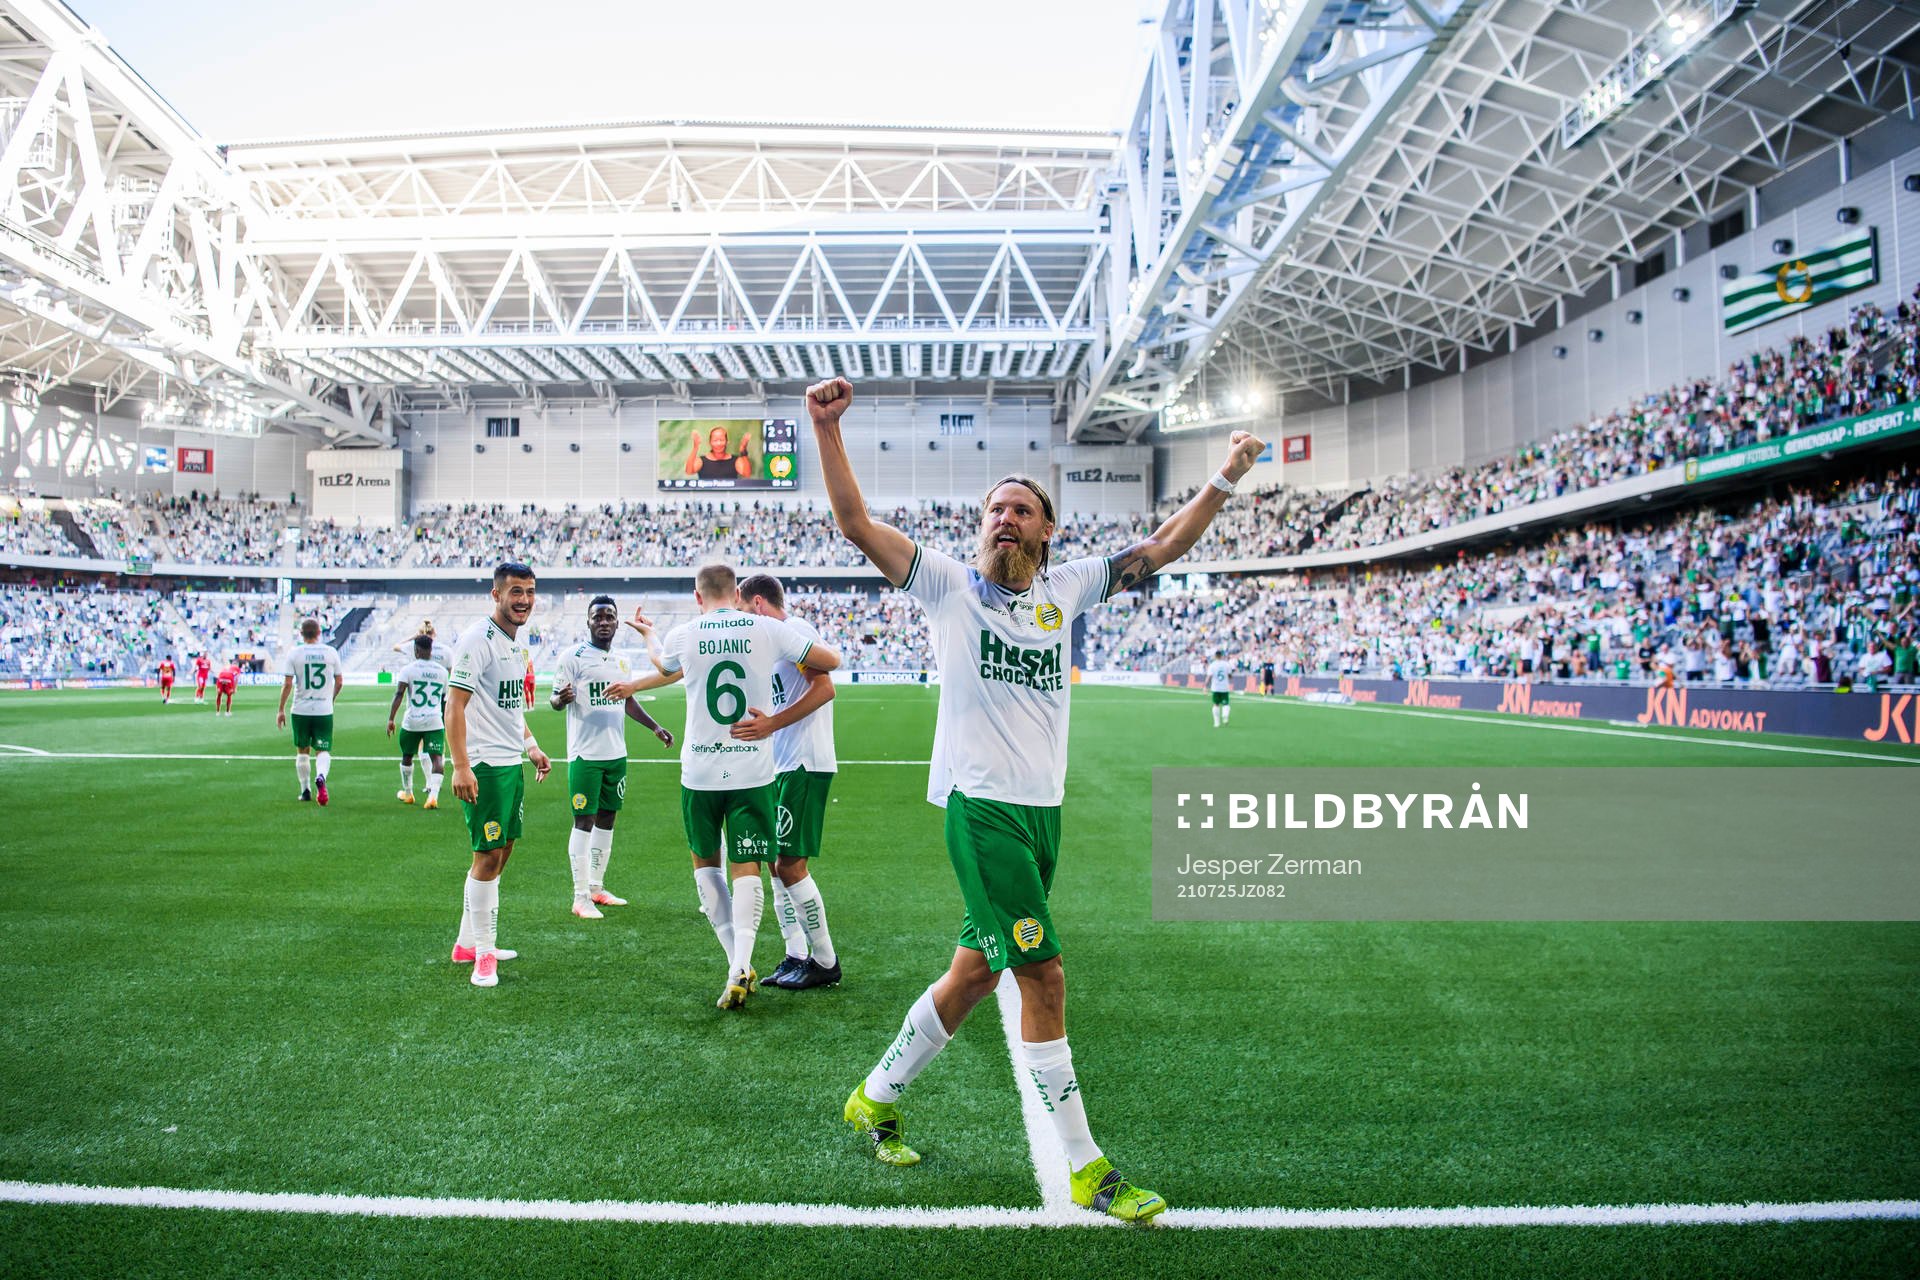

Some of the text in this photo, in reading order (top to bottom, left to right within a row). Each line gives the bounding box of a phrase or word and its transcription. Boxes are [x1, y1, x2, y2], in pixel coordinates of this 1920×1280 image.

[1853, 411, 1905, 438] RESPEKT
[319, 473, 391, 487] TELE2 Arena
[1066, 468, 1142, 482] TELE2 Arena
[699, 618, 754, 629] limitado
[699, 639, 752, 655] BOJANIC
[304, 663, 327, 690] 13
[981, 664, 1063, 692] CHOCOLATE
[411, 681, 444, 708] 33
[706, 660, 747, 726] 6
[1531, 701, 1582, 718] ADVOKAT
[1689, 709, 1767, 732] ADVOKAT
[691, 744, 759, 754] Sefina pantbank
